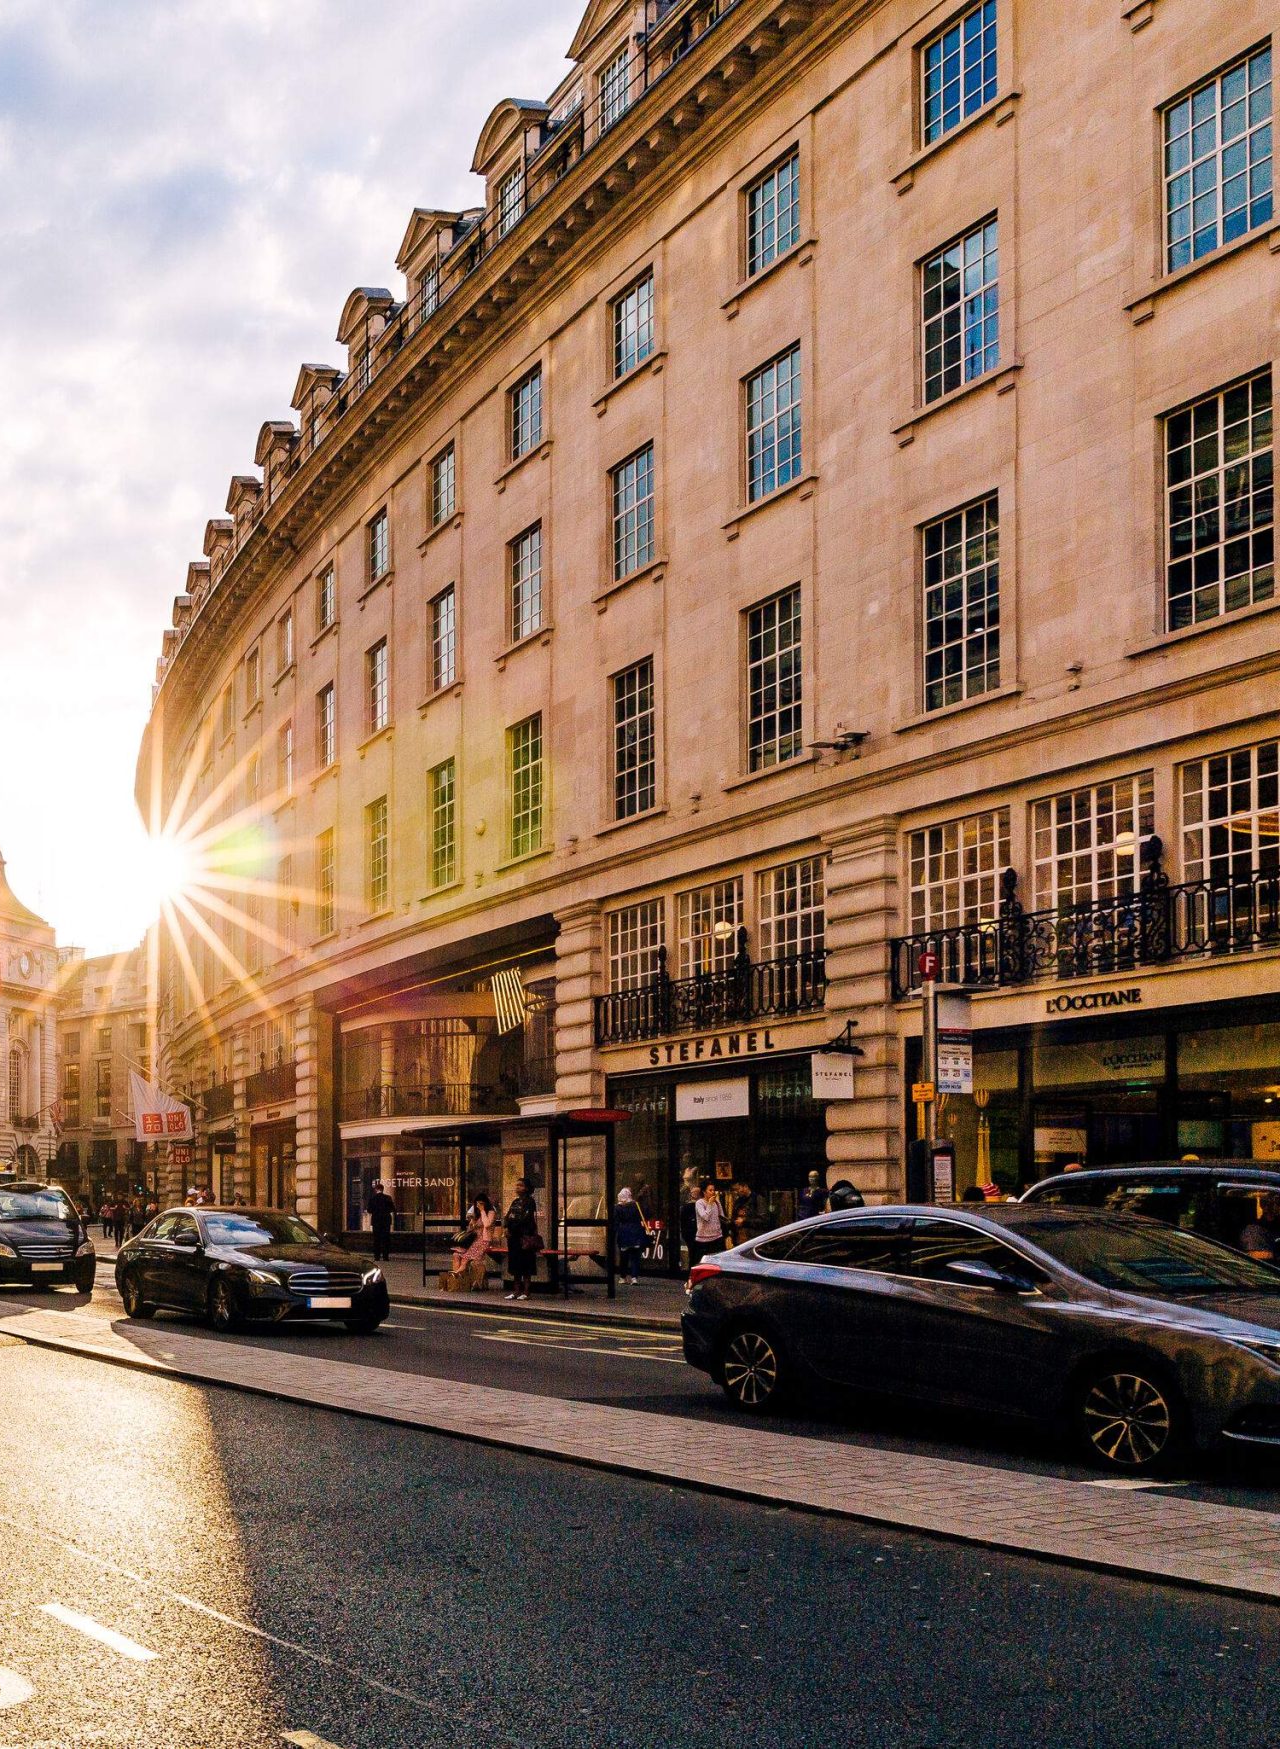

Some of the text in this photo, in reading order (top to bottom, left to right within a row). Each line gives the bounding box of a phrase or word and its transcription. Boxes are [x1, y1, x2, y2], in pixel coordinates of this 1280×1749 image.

[925, 956, 935, 973] F
[1046, 988, 1142, 1013] L'OCCITANE
[649, 1030, 775, 1065] STEFANEL
